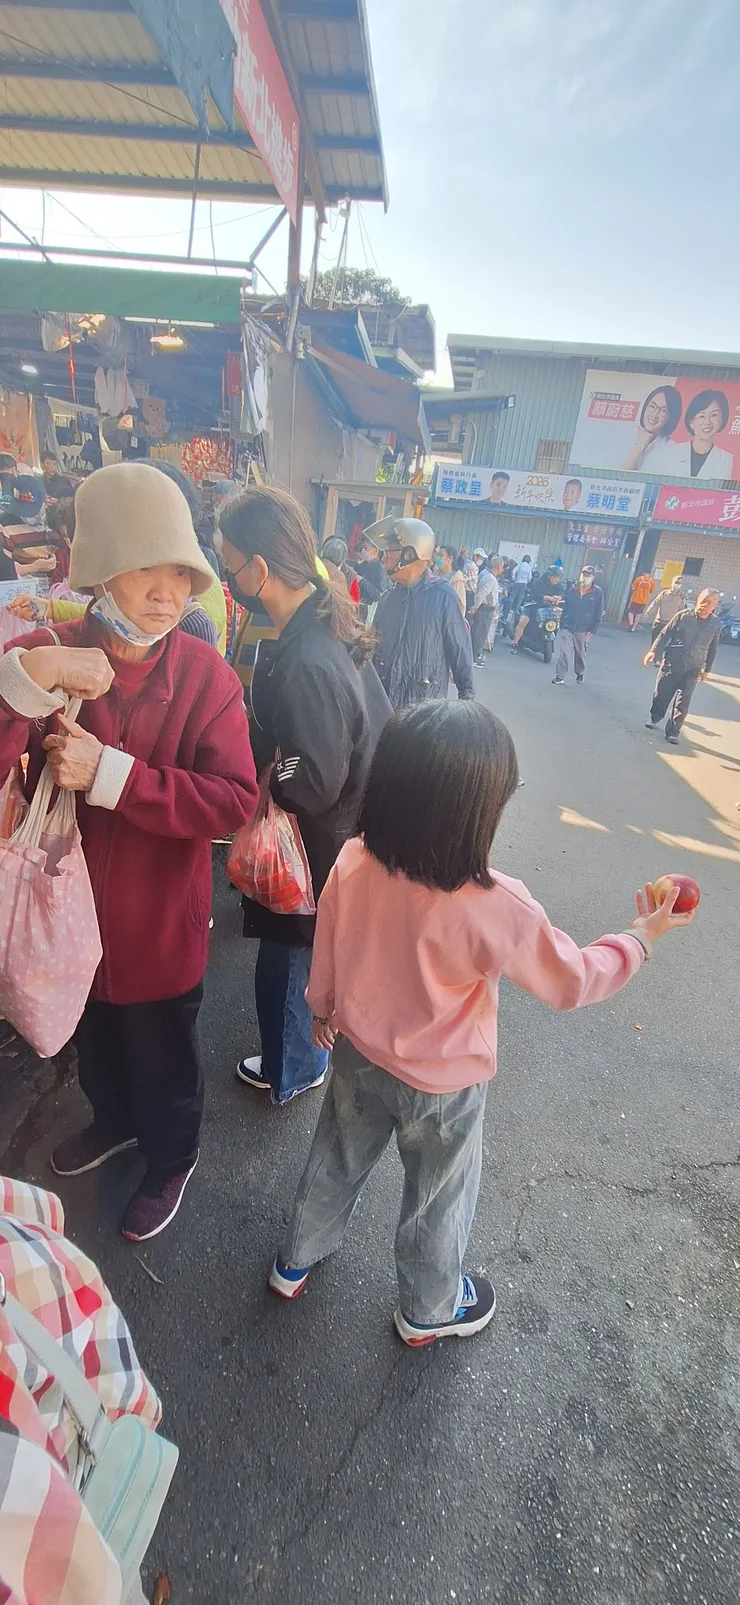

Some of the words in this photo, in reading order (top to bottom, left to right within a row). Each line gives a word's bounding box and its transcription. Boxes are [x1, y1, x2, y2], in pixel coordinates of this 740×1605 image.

[443, 469, 477, 479] 服務處執行長
[441, 478, 481, 496] 蔡政呈
[526, 475, 549, 488] 2026
[514, 484, 555, 504] 新年快樂
[590, 484, 640, 494] 新北市政府市政顧問
[587, 493, 632, 512] 蔡明堂
[681, 498, 715, 509] 新北市議員
